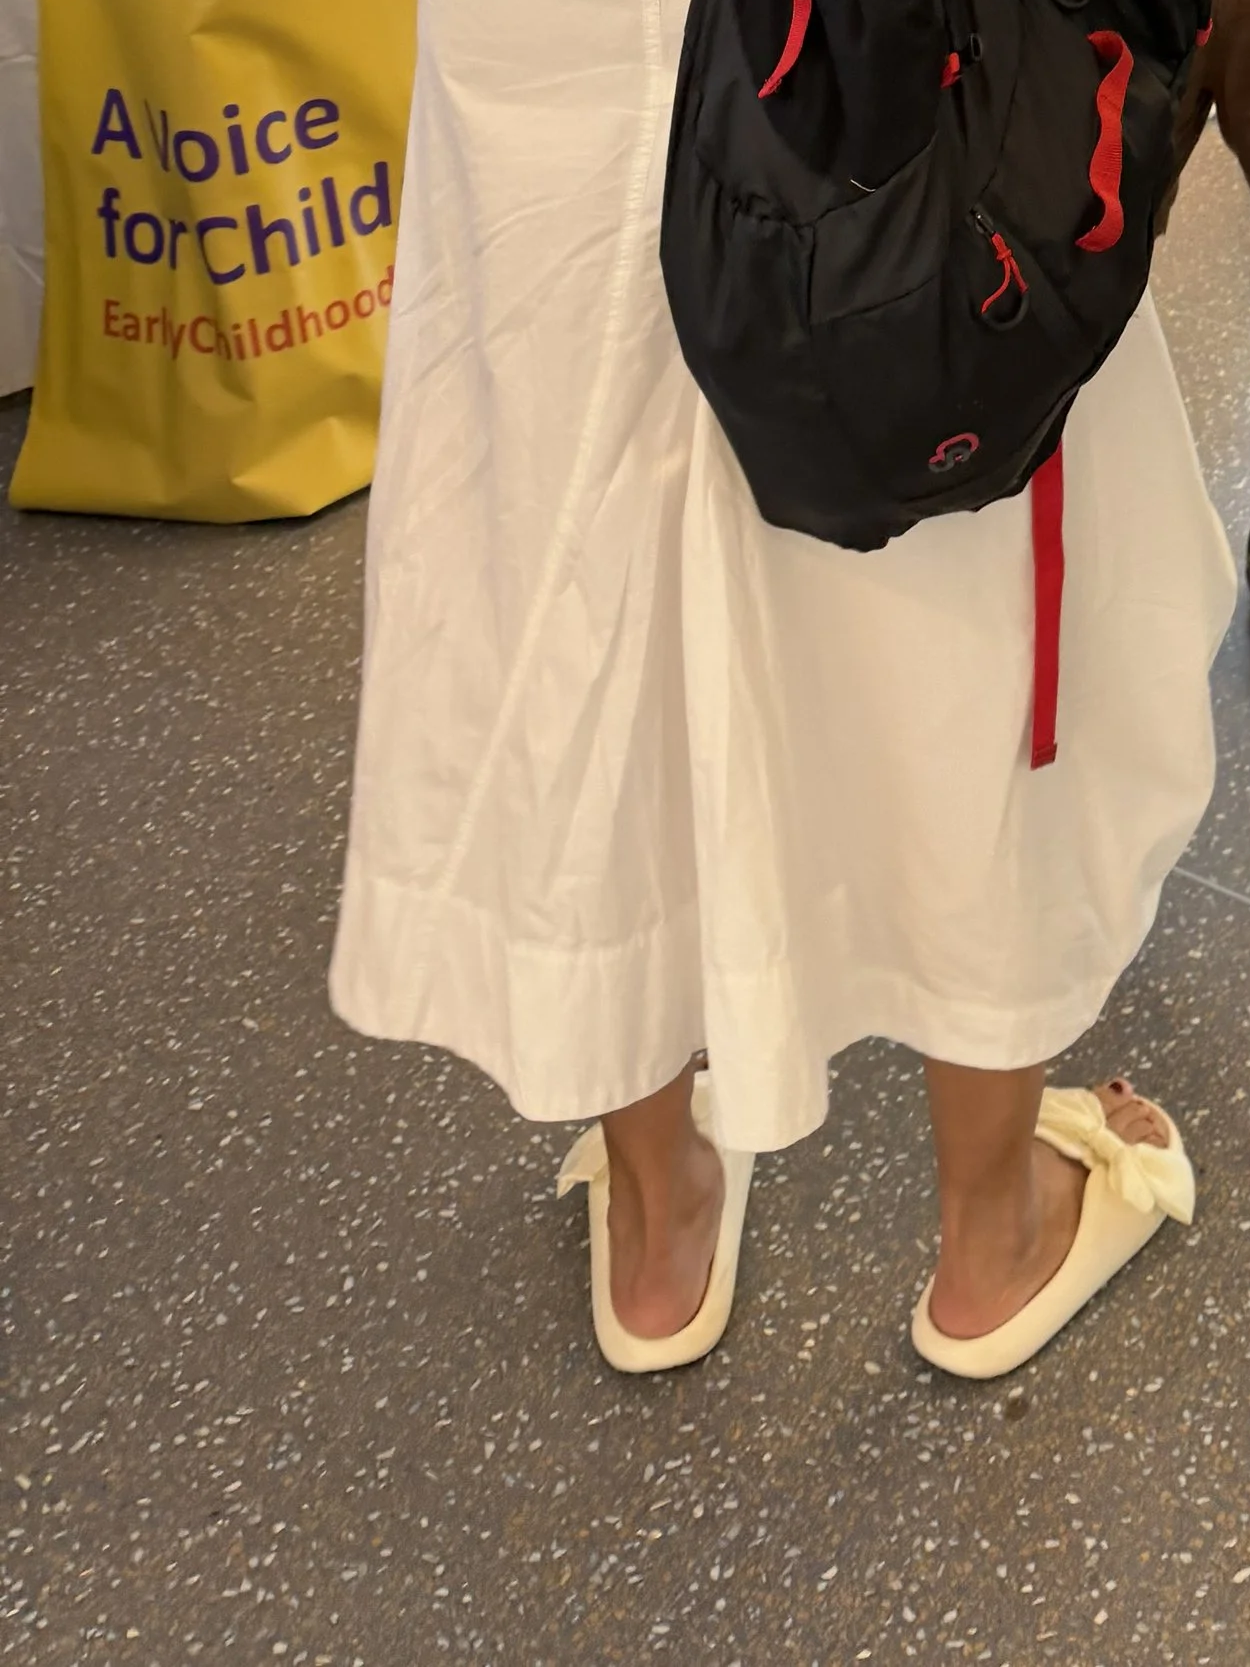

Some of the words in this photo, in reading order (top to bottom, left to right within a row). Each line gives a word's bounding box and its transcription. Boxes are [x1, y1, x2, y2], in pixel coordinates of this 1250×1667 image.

[91, 88, 142, 160] A
[144, 96, 340, 183] Voice
[97, 186, 187, 271] for
[196, 161, 403, 286] Child
[103, 298, 186, 361] Early
[188, 264, 395, 362] Childhood
